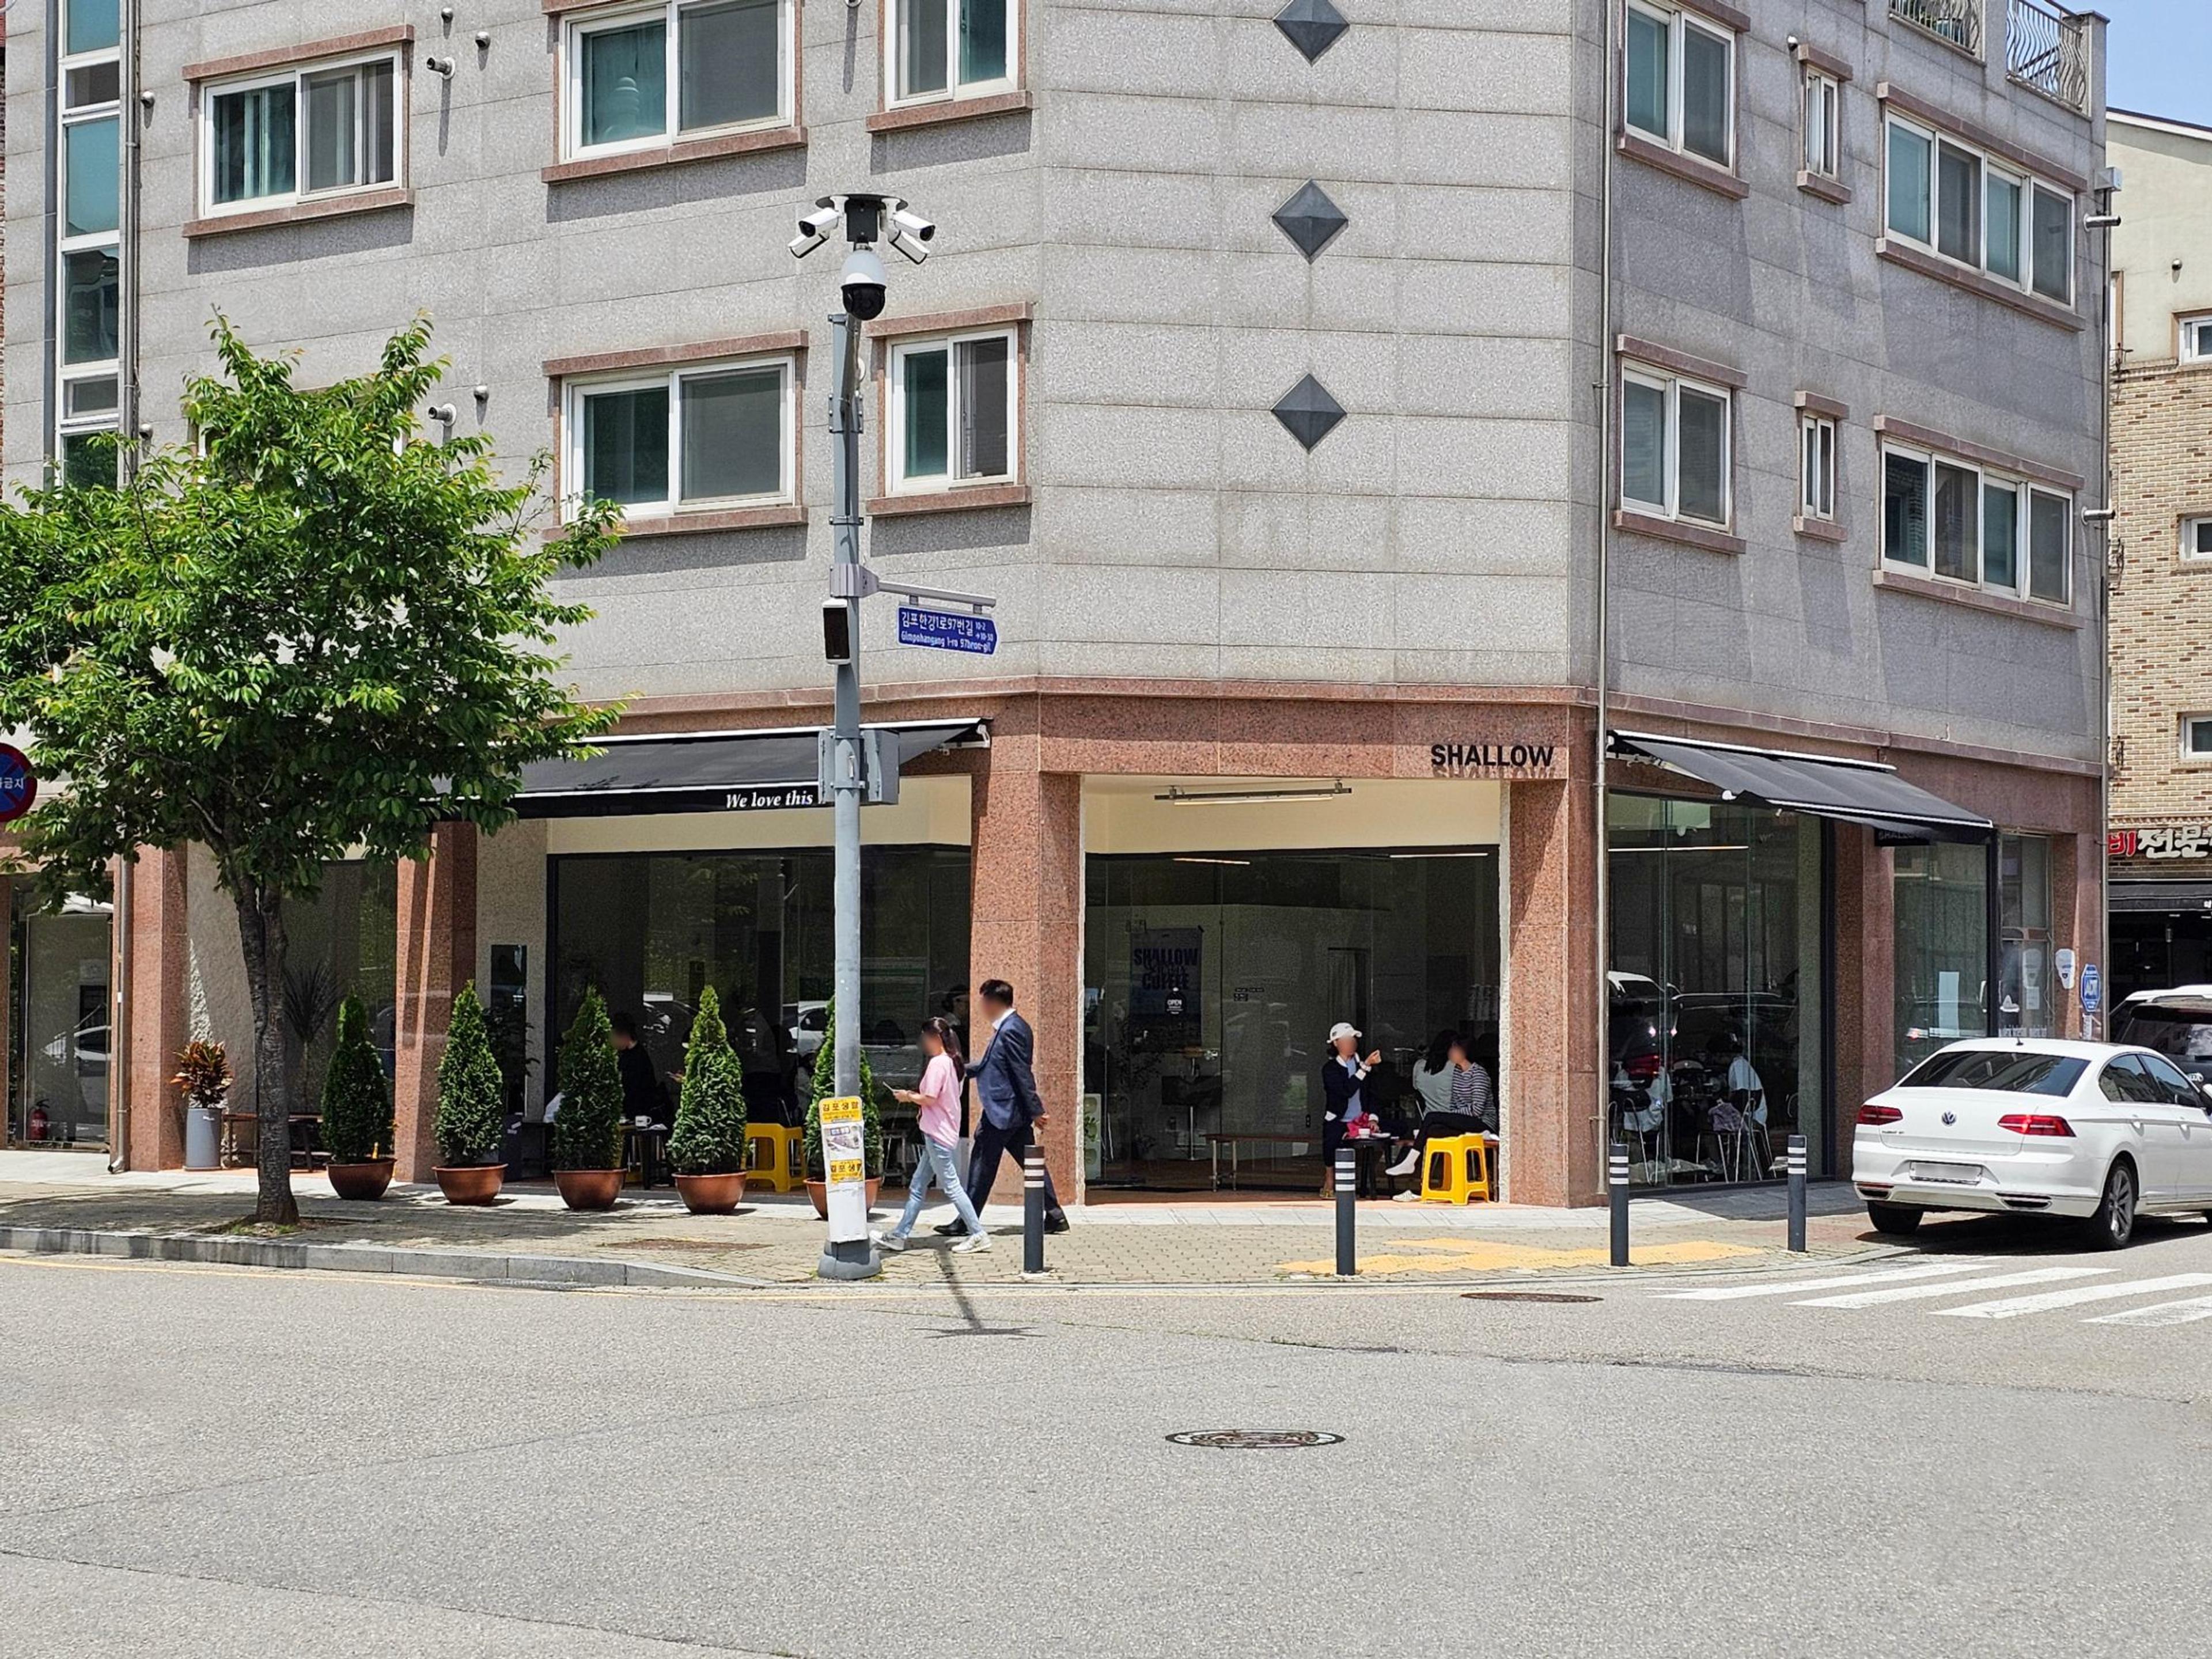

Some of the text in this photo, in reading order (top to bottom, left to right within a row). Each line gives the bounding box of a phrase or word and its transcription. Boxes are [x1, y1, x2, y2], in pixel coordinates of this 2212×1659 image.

[901, 631, 945, 647] Gimpohangang
[1431, 744, 1554, 767] SHALLOW
[726, 790, 813, 808] We love this
